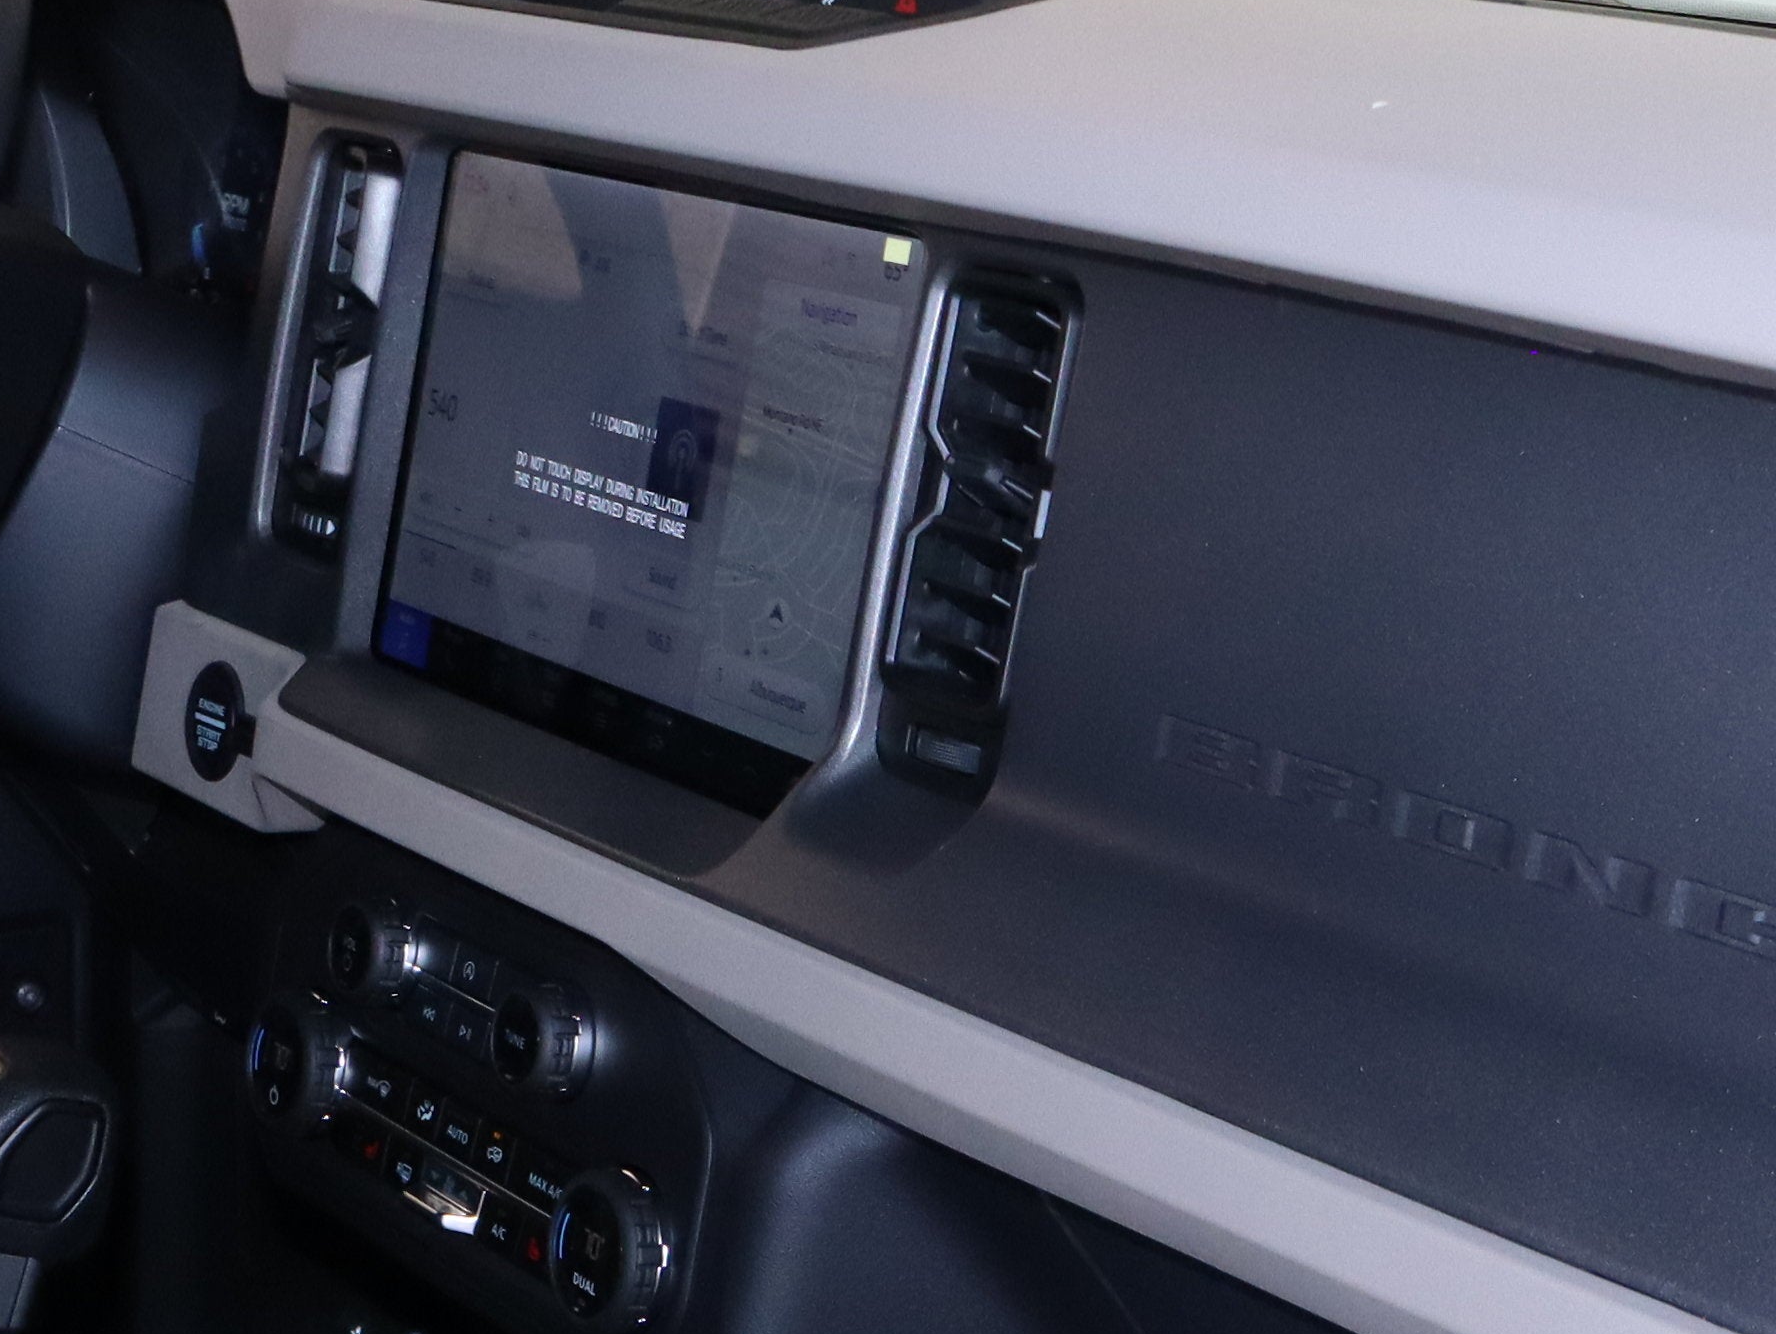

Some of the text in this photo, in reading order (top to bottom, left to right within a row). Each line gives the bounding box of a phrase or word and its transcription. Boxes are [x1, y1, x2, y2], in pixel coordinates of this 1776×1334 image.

[516, 450, 690, 518] DO NOT TOUCH DISPLAY DURING INSTALLATION
[514, 470, 687, 540] THIS FILM IS TO BE REMOVED BEFORE USAGE
[446, 1123, 469, 1146] AUTO
[528, 1172, 547, 1194] MAX
[572, 1271, 597, 1298] DUAL
